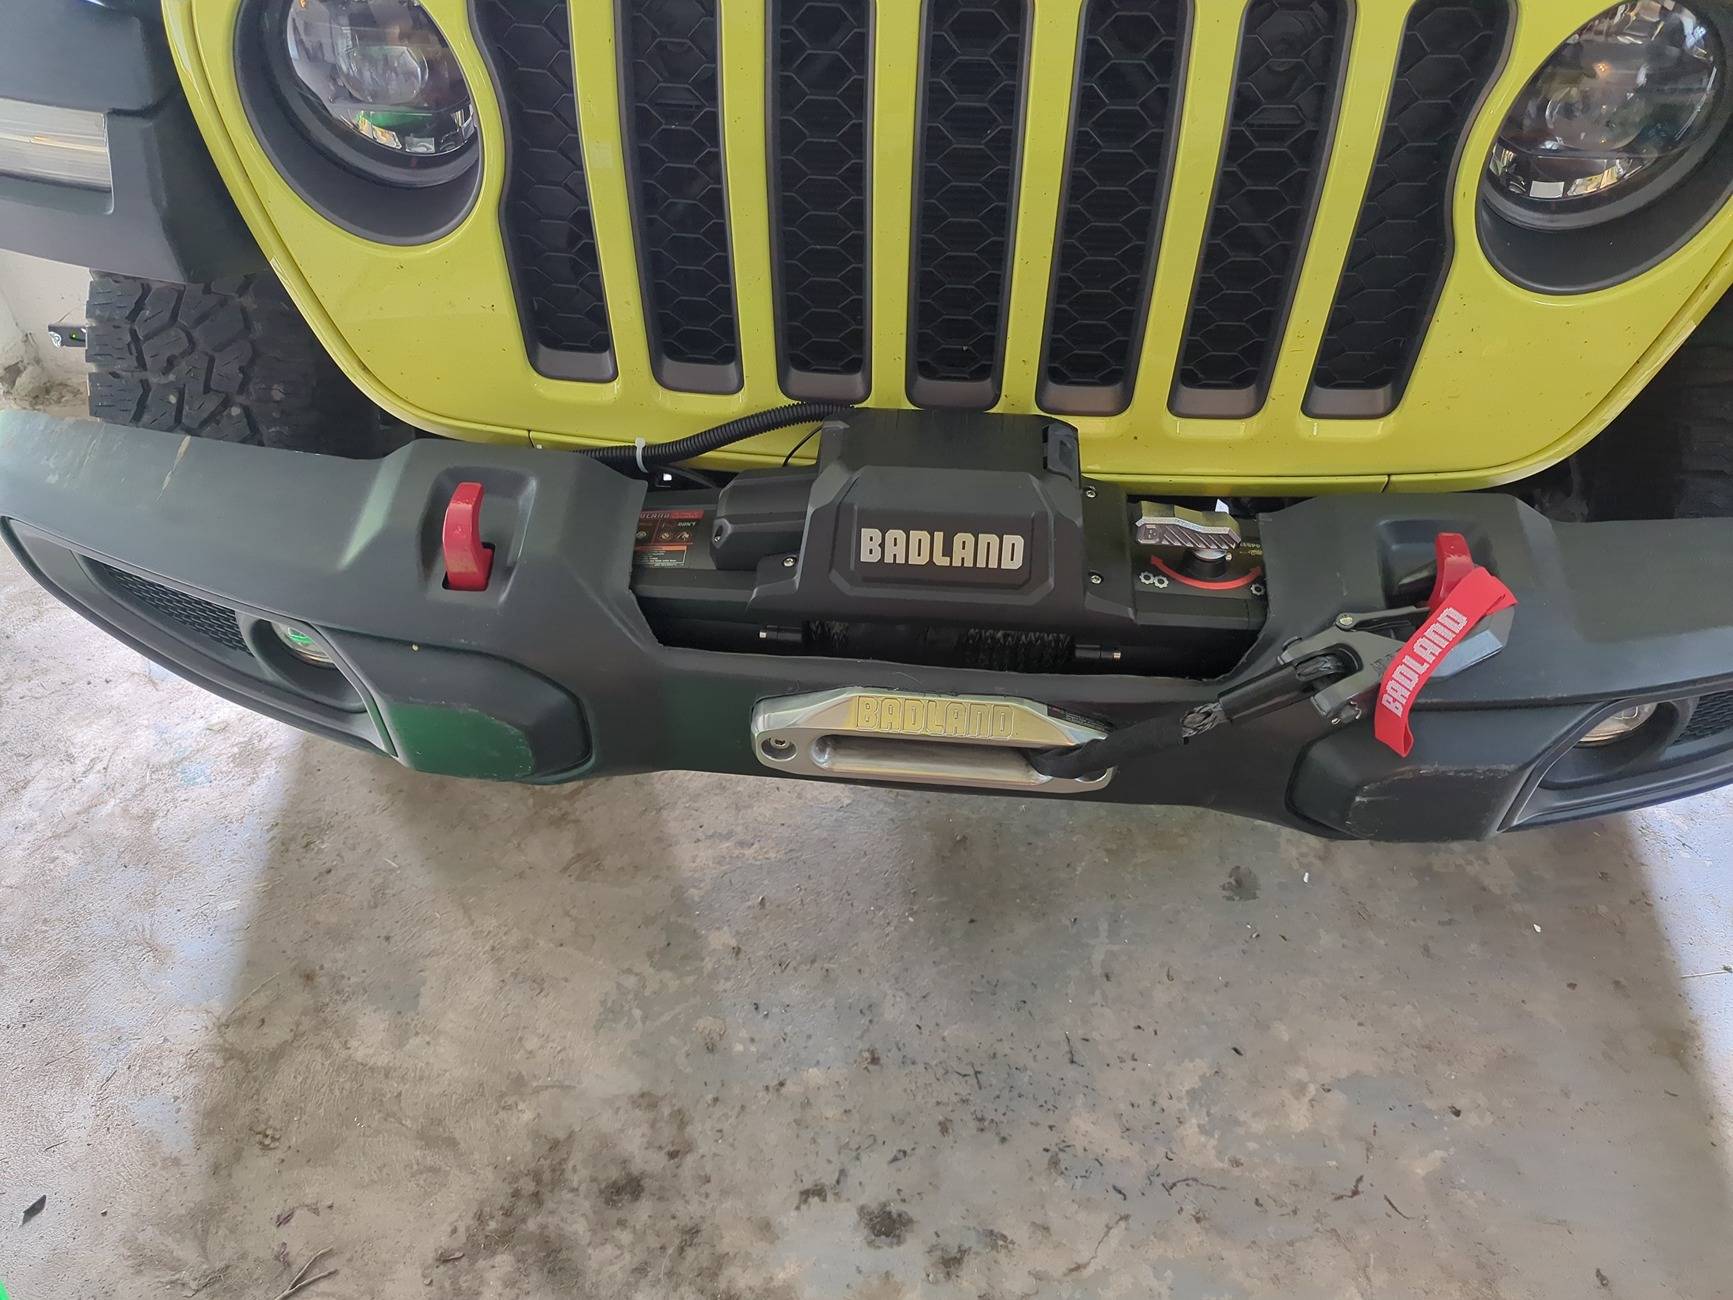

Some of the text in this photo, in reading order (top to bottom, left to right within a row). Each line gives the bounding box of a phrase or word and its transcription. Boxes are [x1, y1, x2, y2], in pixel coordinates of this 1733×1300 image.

[860, 528, 1024, 569] BADLAND
[1382, 607, 1468, 718] BADLAND
[857, 696, 1014, 739] BADLAND
